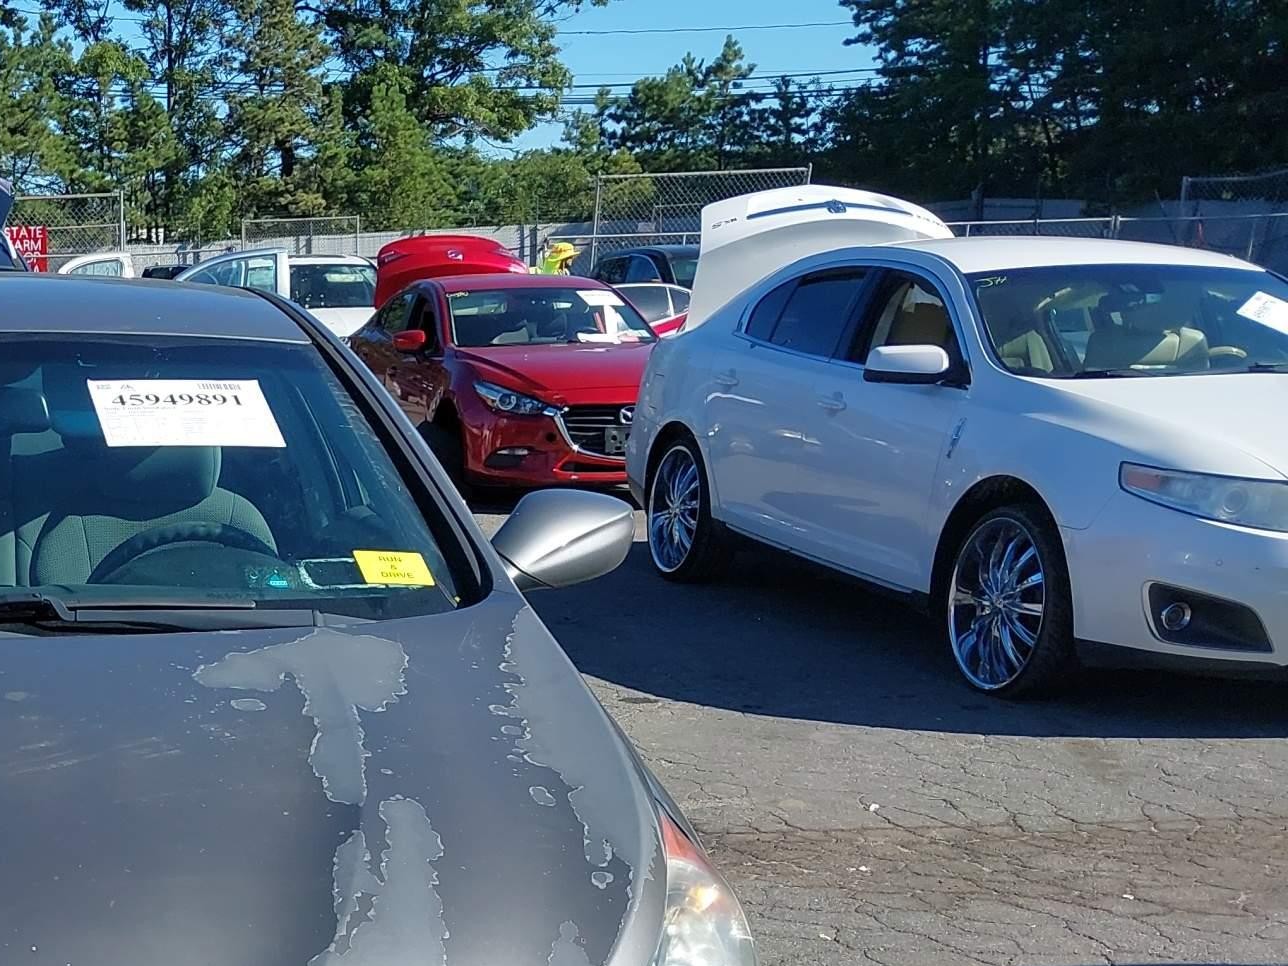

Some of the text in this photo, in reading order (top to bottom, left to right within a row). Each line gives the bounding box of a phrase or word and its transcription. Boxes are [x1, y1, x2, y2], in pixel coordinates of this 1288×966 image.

[3, 226, 44, 238] STATE
[10, 239, 42, 251] ARM
[111, 393, 243, 407] 45949891
[378, 555, 402, 563] RUN
[380, 571, 415, 579] DRIVE
